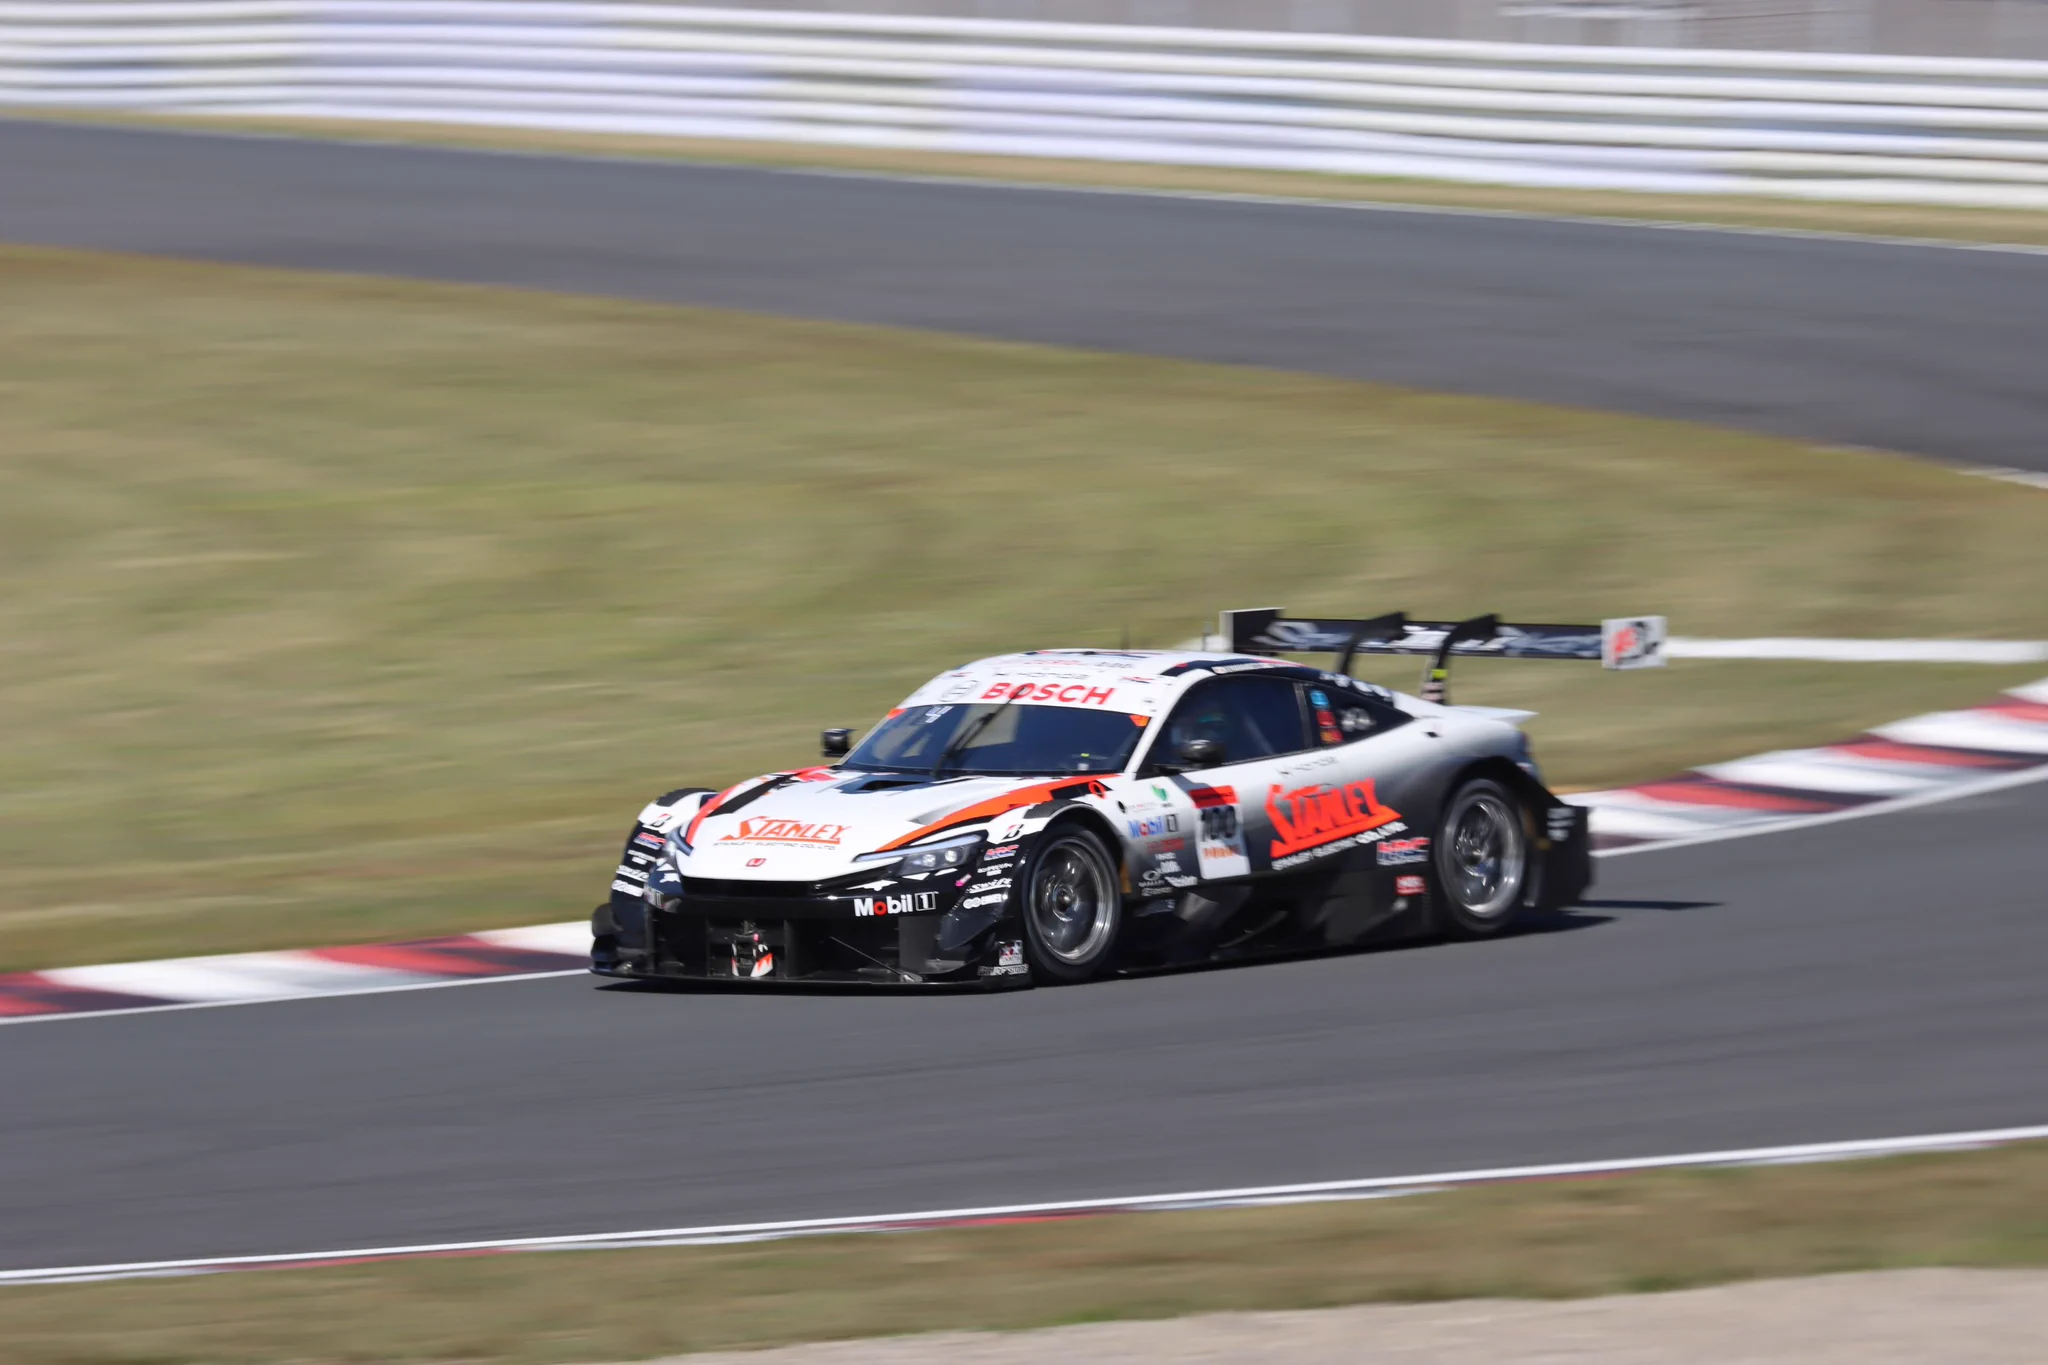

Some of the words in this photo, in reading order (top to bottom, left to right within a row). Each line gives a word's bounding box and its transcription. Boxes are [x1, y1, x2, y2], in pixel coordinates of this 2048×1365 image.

[980, 682, 1116, 706] BOSCH
[719, 815, 851, 844] STANLEY
[1265, 776, 1402, 858] STANLEY
[854, 894, 913, 917] Mobil
